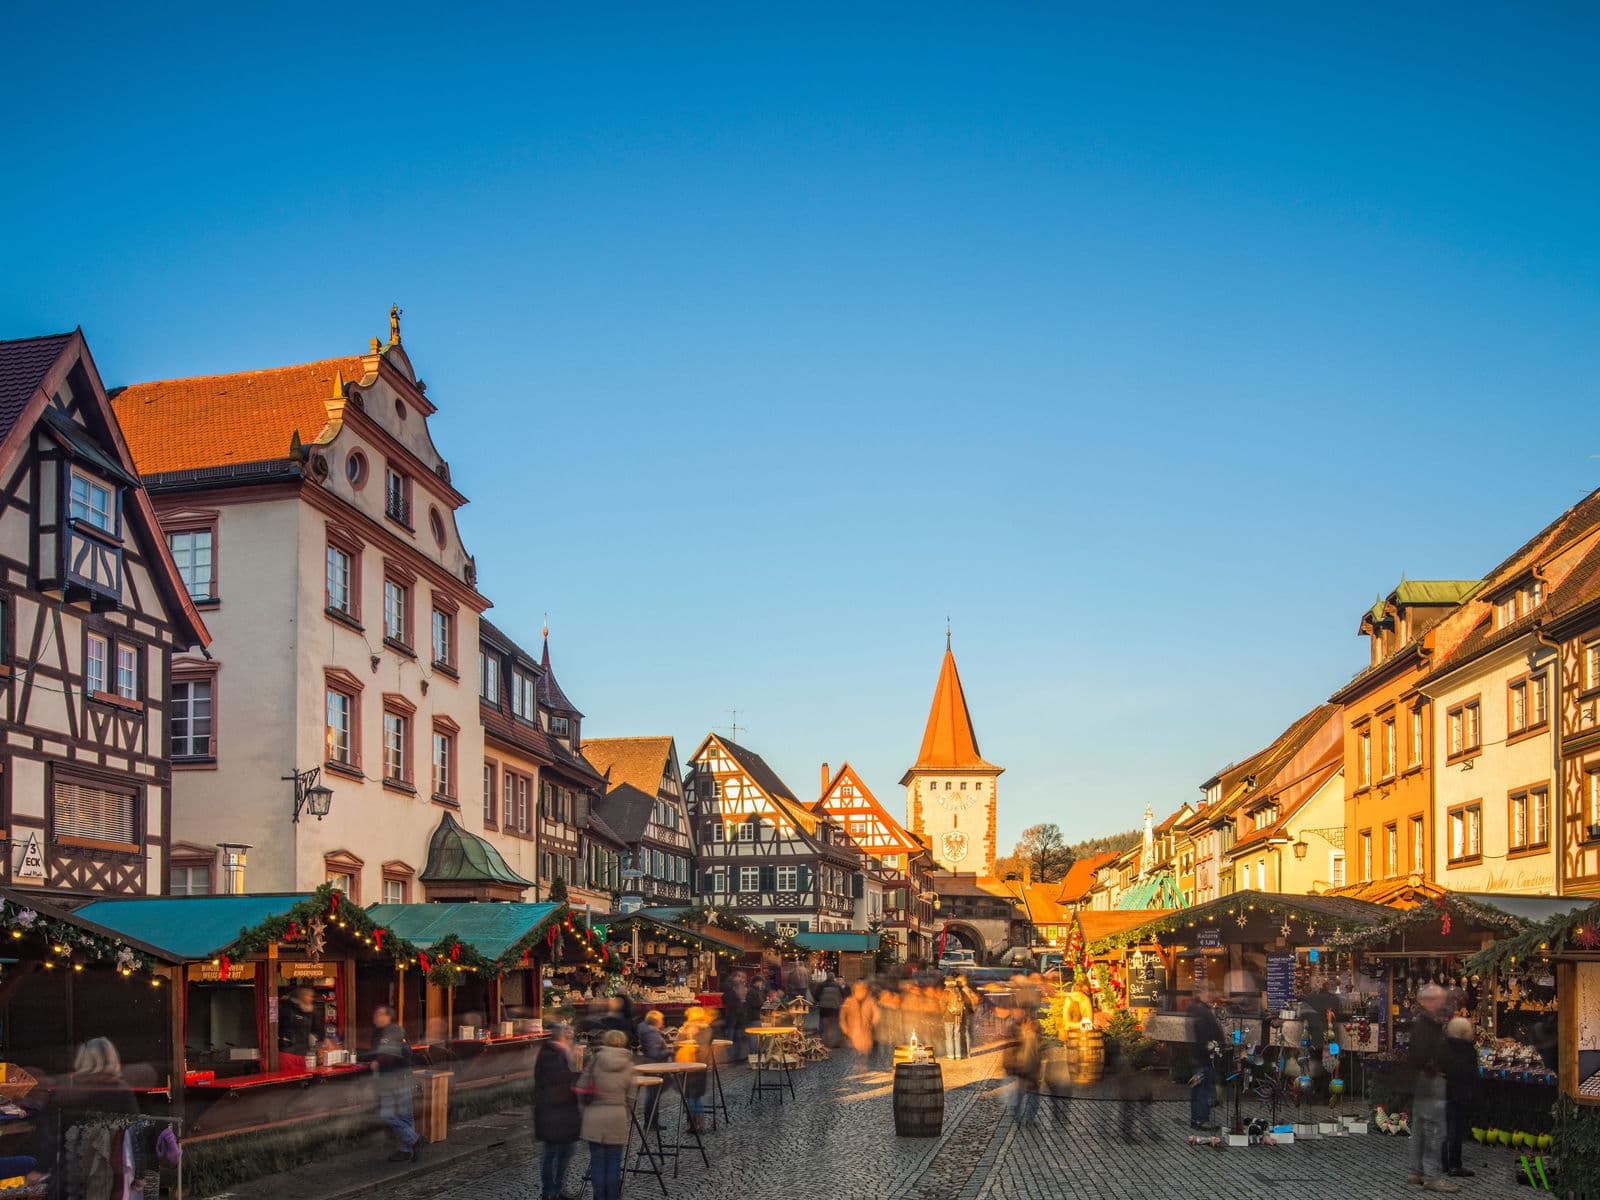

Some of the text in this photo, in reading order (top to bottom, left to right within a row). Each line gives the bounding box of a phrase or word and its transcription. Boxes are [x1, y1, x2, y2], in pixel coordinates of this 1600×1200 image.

[30, 843, 36, 855] 3
[25, 857, 41, 867] ECK
[778, 927, 794, 937] WC
